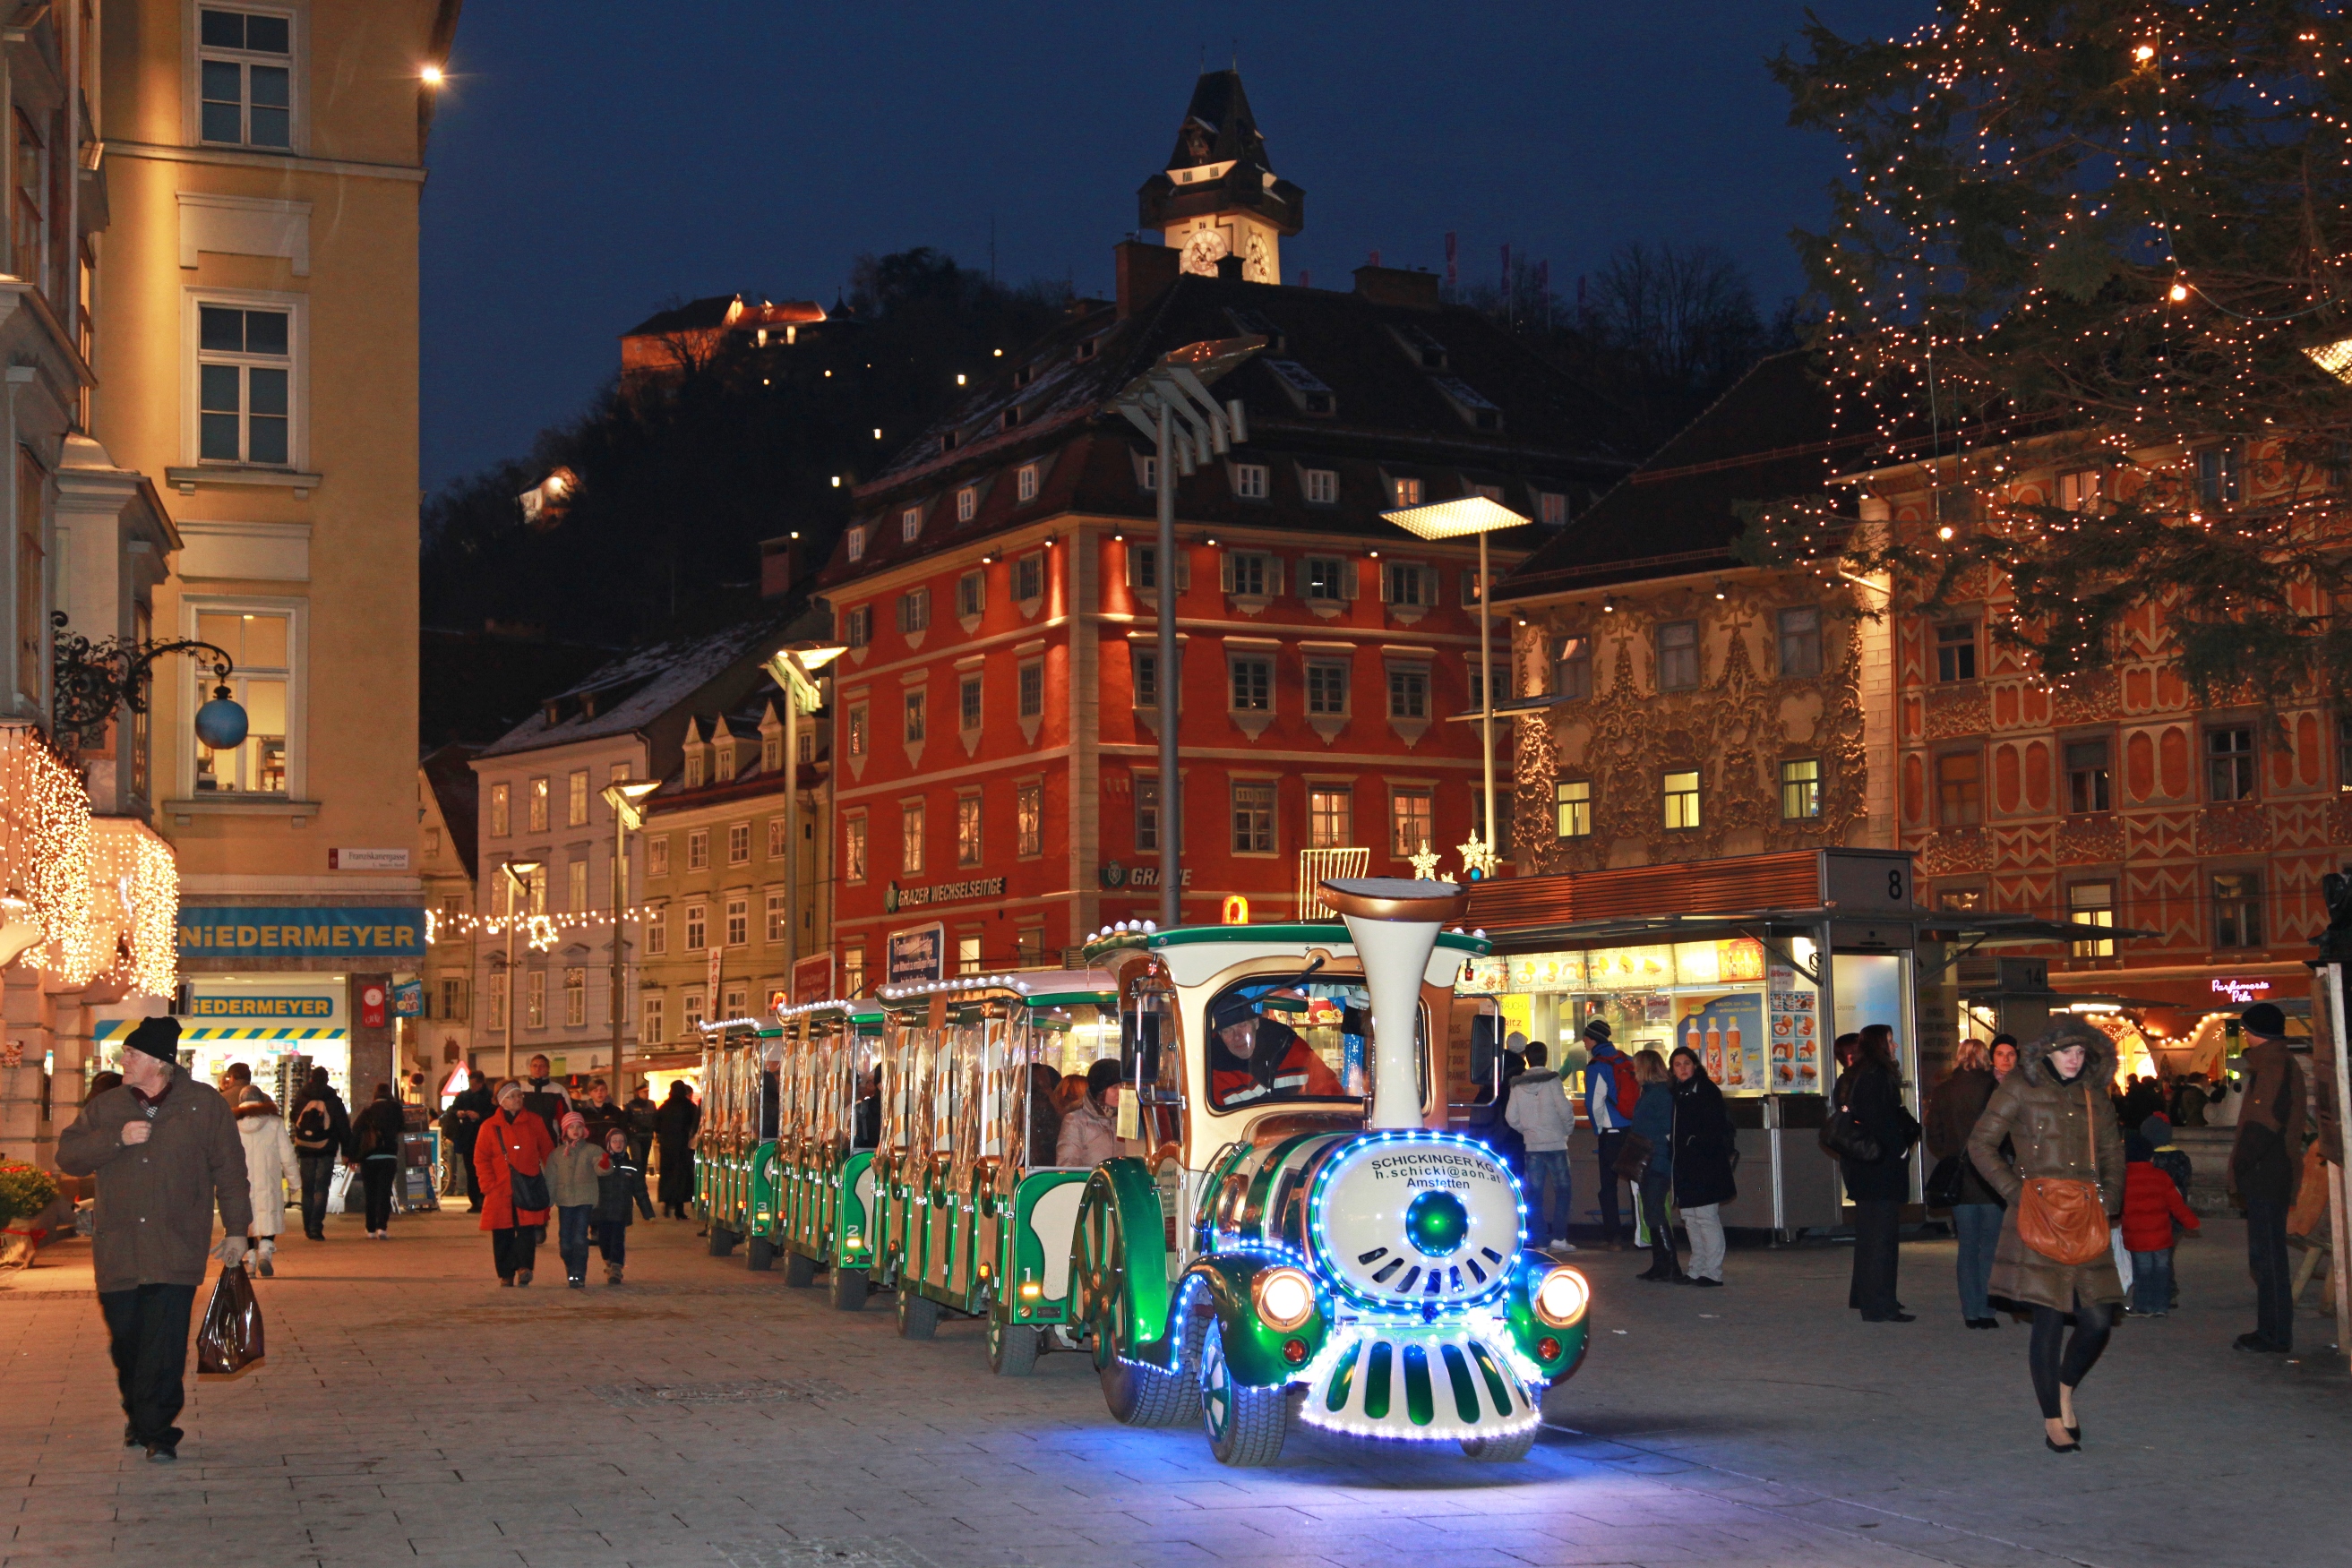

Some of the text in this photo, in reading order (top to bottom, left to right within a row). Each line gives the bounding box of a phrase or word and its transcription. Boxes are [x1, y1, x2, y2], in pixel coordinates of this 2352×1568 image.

[1131, 868, 1192, 886] GRAE
[1888, 870, 1902, 900] 8
[898, 878, 1002, 906] GRAZER WECHSELSEITIGE
[711, 951, 720, 1019] APOTHE
[2025, 968, 2043, 986] 14
[193, 999, 329, 1014] iEDERMEYER
[1449, 1024, 1461, 1033] ROS
[1371, 1154, 1495, 1173] SCHICKINGER KG
[1375, 1166, 1501, 1184] h.schicki@aon.at
[1407, 1178, 1471, 1189] Amstetten
[758, 1202, 768, 1212] 3
[846, 1225, 859, 1237] 2
[1024, 1267, 1031, 1282] 1
